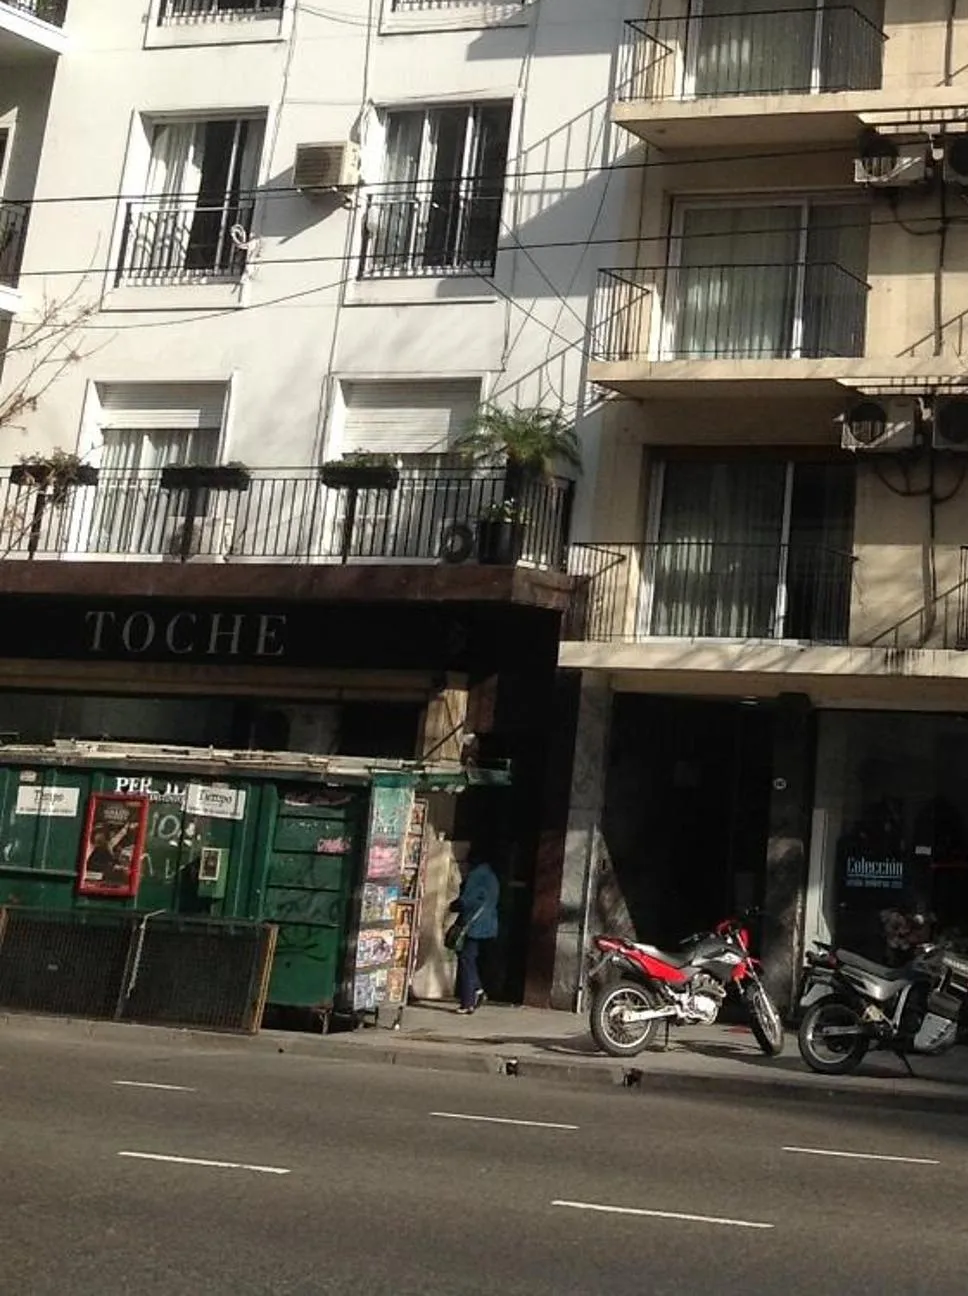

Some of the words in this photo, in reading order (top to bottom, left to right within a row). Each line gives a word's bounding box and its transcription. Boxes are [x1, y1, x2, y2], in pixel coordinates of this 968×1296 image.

[86, 610, 288, 656] TOCHE
[114, 777, 186, 794] PERIL
[847, 856, 903, 876] Colección
